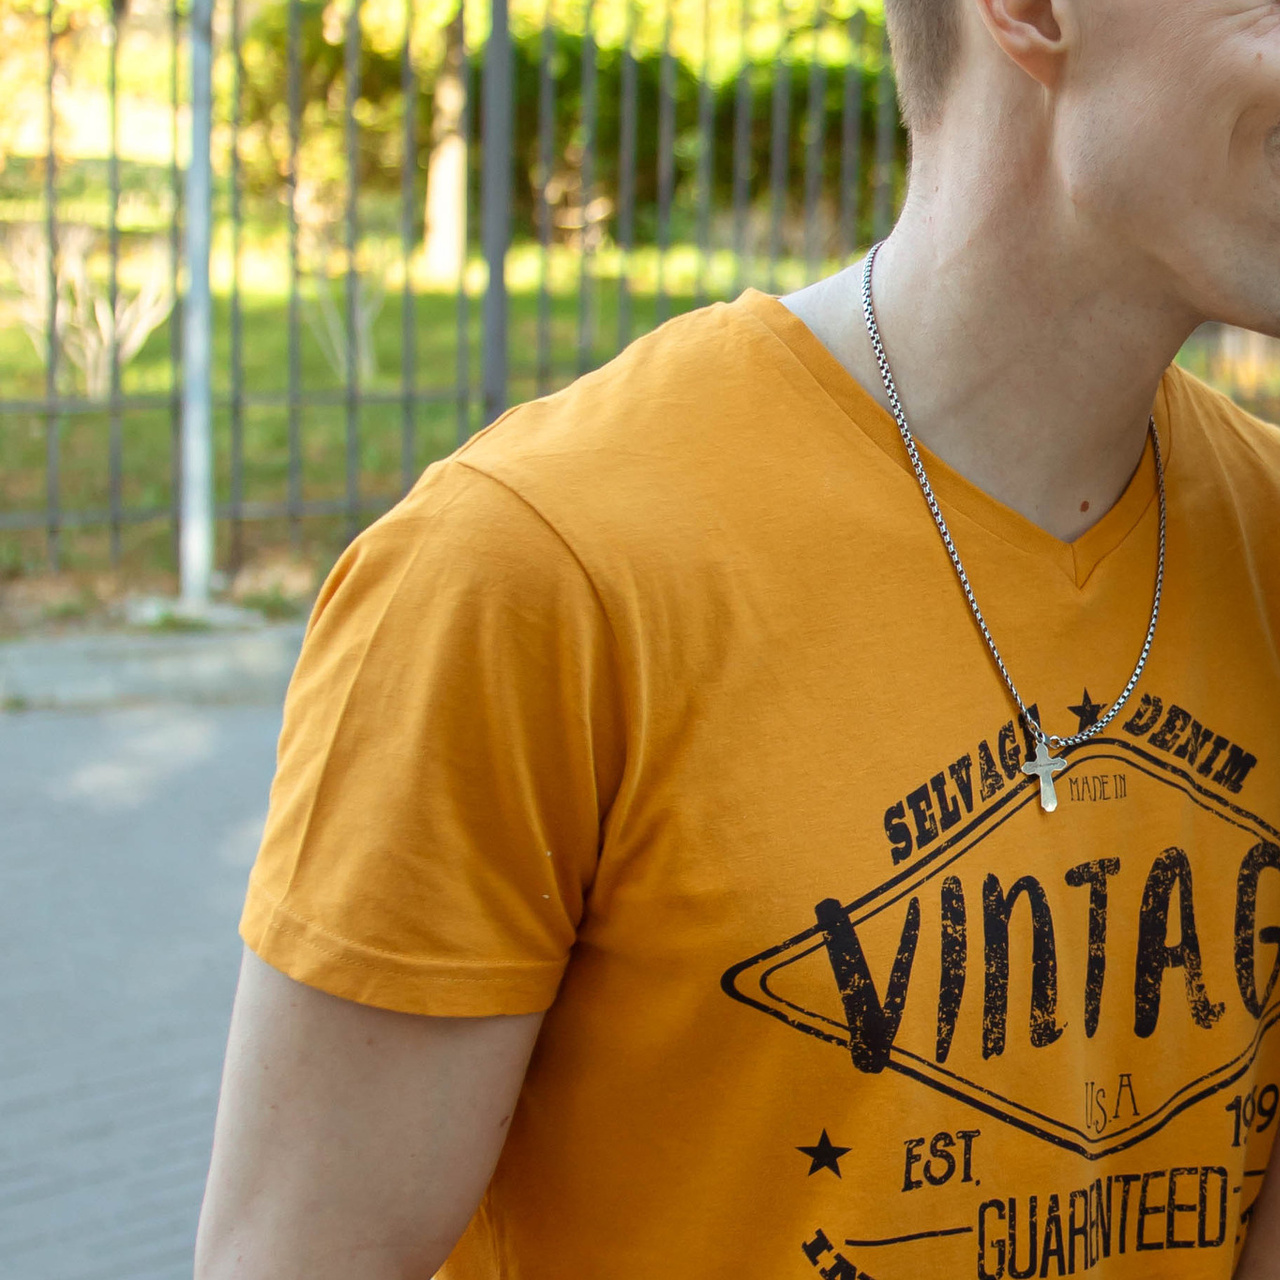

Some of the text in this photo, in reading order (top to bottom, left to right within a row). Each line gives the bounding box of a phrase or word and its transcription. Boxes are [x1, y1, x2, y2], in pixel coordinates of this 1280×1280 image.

[1122, 693, 1258, 794] DENIM
[1069, 773, 1127, 802] MADE IN
[901, 1129, 981, 1192] EST.
